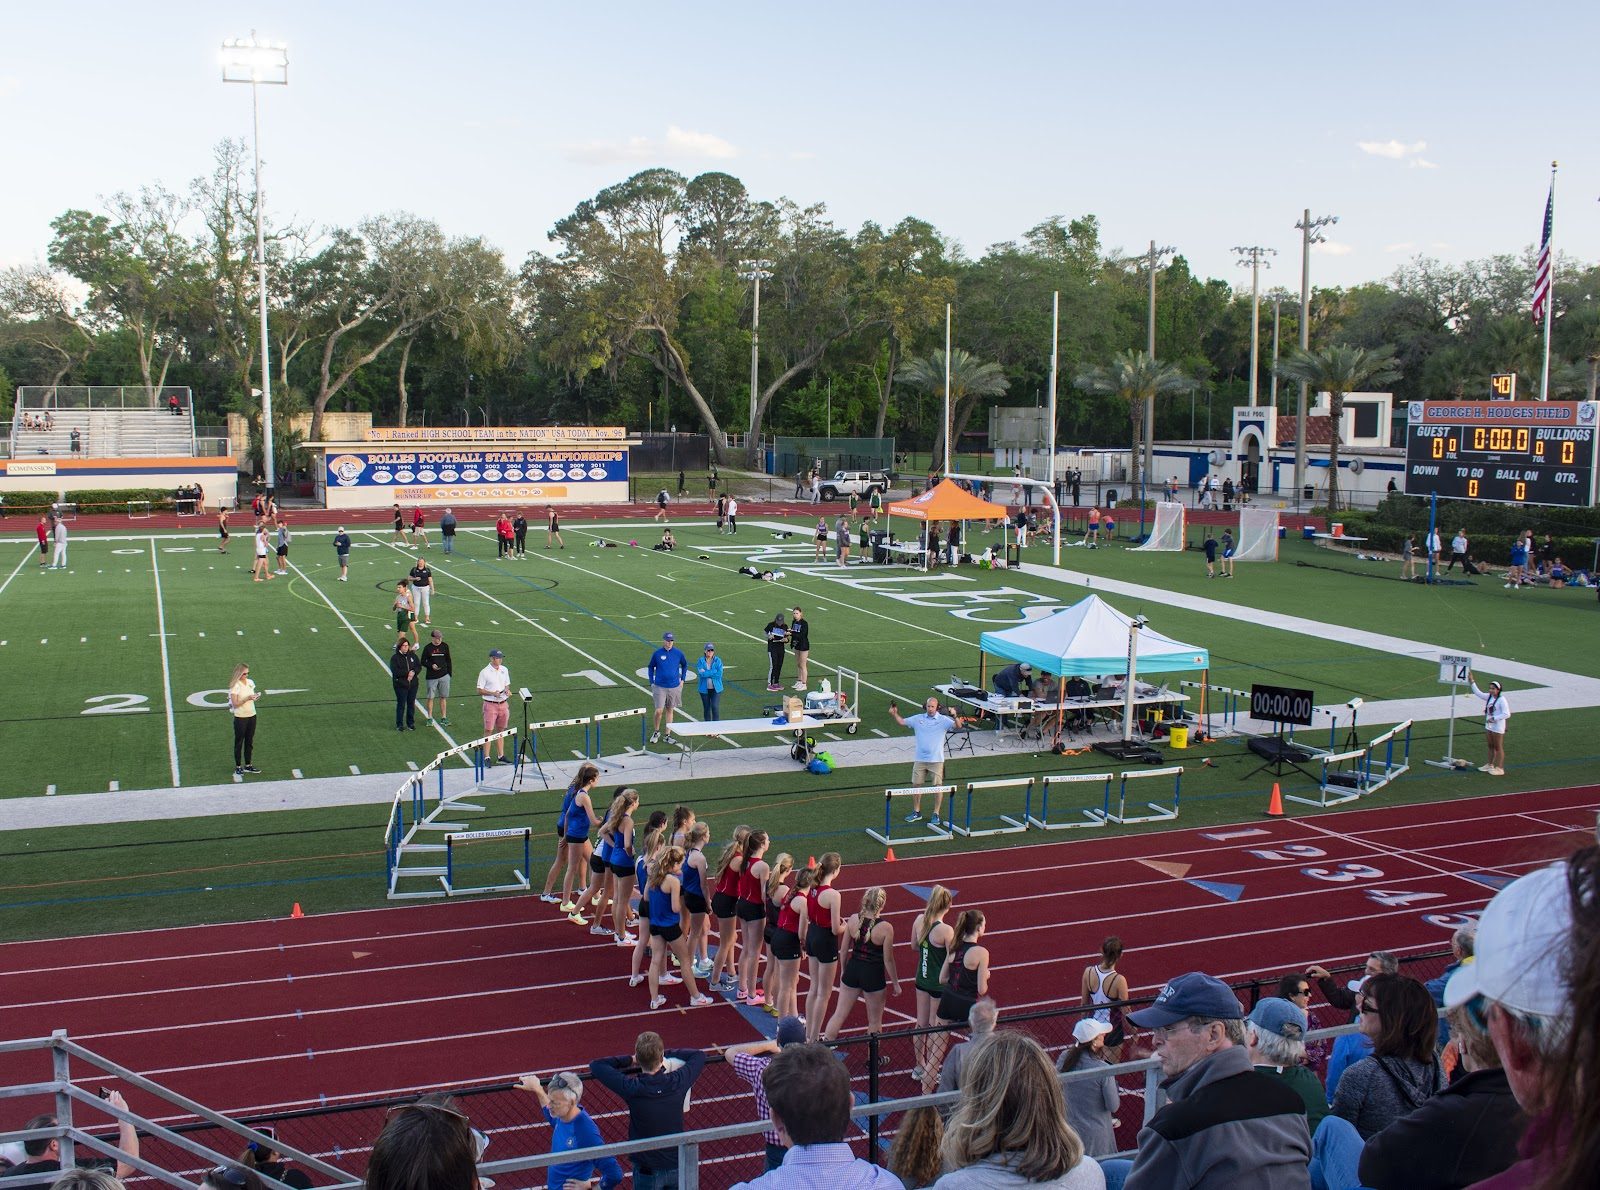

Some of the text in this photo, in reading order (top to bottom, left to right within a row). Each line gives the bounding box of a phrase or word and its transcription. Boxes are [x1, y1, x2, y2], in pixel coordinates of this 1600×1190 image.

[1493, 376, 1510, 394] 40
[1428, 407, 1571, 419] GEORGE H. HODGES FIELD
[392, 430, 418, 439] Ranked
[421, 429, 440, 438] HIGH
[442, 429, 472, 438] SCHOOL
[475, 429, 495, 438] TEAM
[496, 429, 504, 438] in
[506, 429, 517, 438] the
[551, 429, 565, 438] USA
[1417, 426, 1451, 437] GUEST
[1536, 429, 1591, 441] BULLDOGS
[1449, 438, 1457, 452] 0
[1474, 428, 1528, 451] 0:00.0
[1432, 437, 1443, 459] 0
[1535, 440, 1544, 455] 0
[1562, 441, 1574, 464] 0
[368, 452, 623, 464] BOLLES FOOTBALL STATE CHAMPIONSHIPS
[1532, 455, 1545, 463] TOL
[1412, 466, 1439, 476] DOWN
[1456, 467, 1484, 478] TO GO
[1495, 469, 1538, 481] BALL ON
[1555, 472, 1578, 484] QTR.
[1468, 479, 1478, 497] 0
[1515, 482, 1525, 500] 0
[686, 541, 1070, 624] BOLLES
[1457, 665, 1466, 681] 4
[1254, 692, 1310, 719] 00:00.00
[1199, 828, 1272, 841] 1
[1242, 844, 1327, 860] 2
[1300, 863, 1385, 882] 3
[1363, 889, 1448, 907] 4
